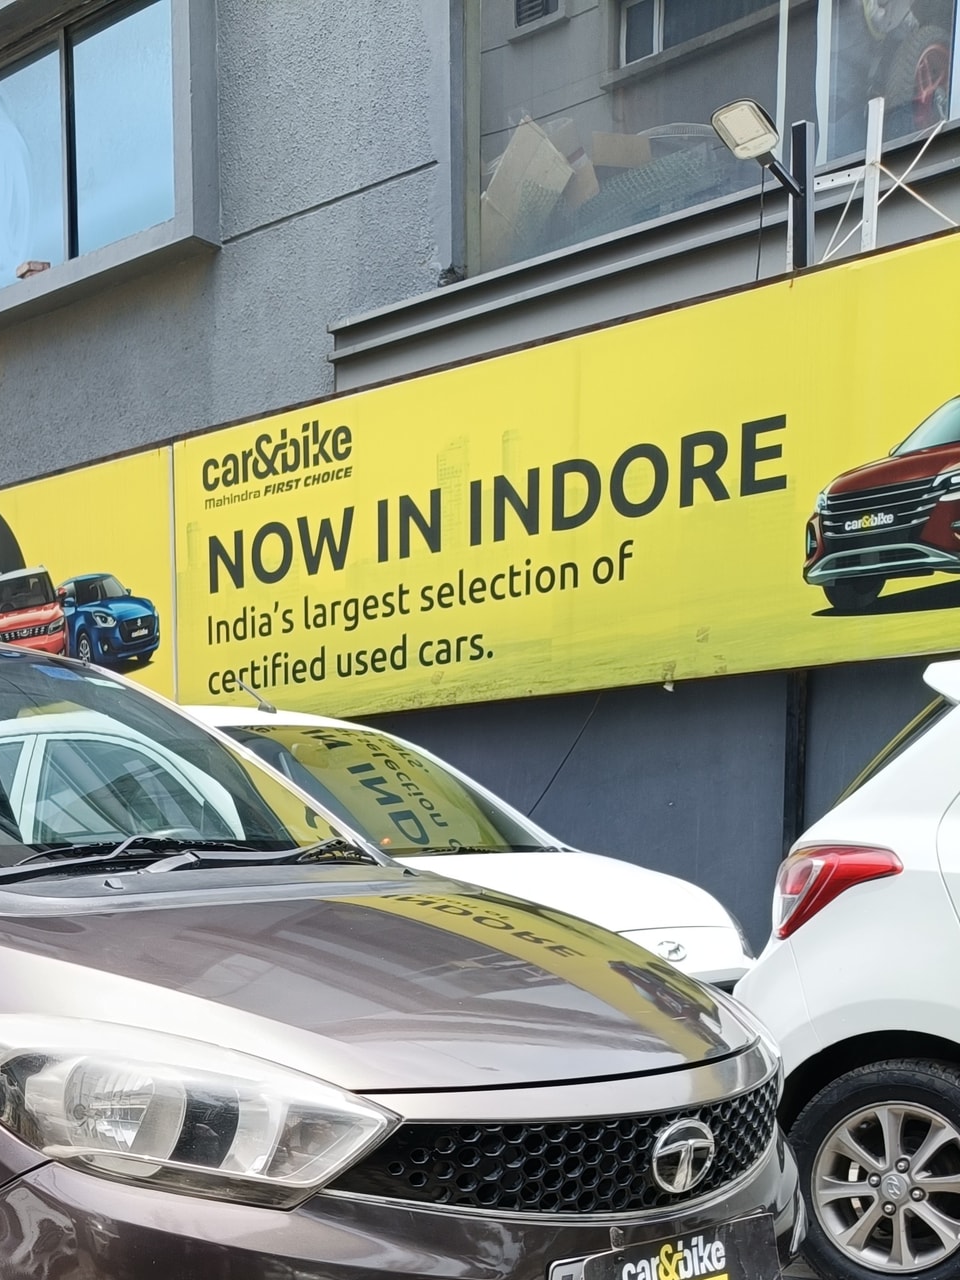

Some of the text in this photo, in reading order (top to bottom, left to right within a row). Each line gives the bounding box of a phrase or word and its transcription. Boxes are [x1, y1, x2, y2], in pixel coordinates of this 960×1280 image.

[202, 419, 353, 491] car&bike
[204, 466, 353, 510] Mahindra FIRST CHOICE
[208, 414, 787, 594] NOW IN INDORE
[844, 512, 894, 531] car&bike
[303, 583, 411, 632] largest
[419, 558, 580, 613] selection
[592, 539, 635, 585] of
[208, 633, 494, 696] certified used cars.
